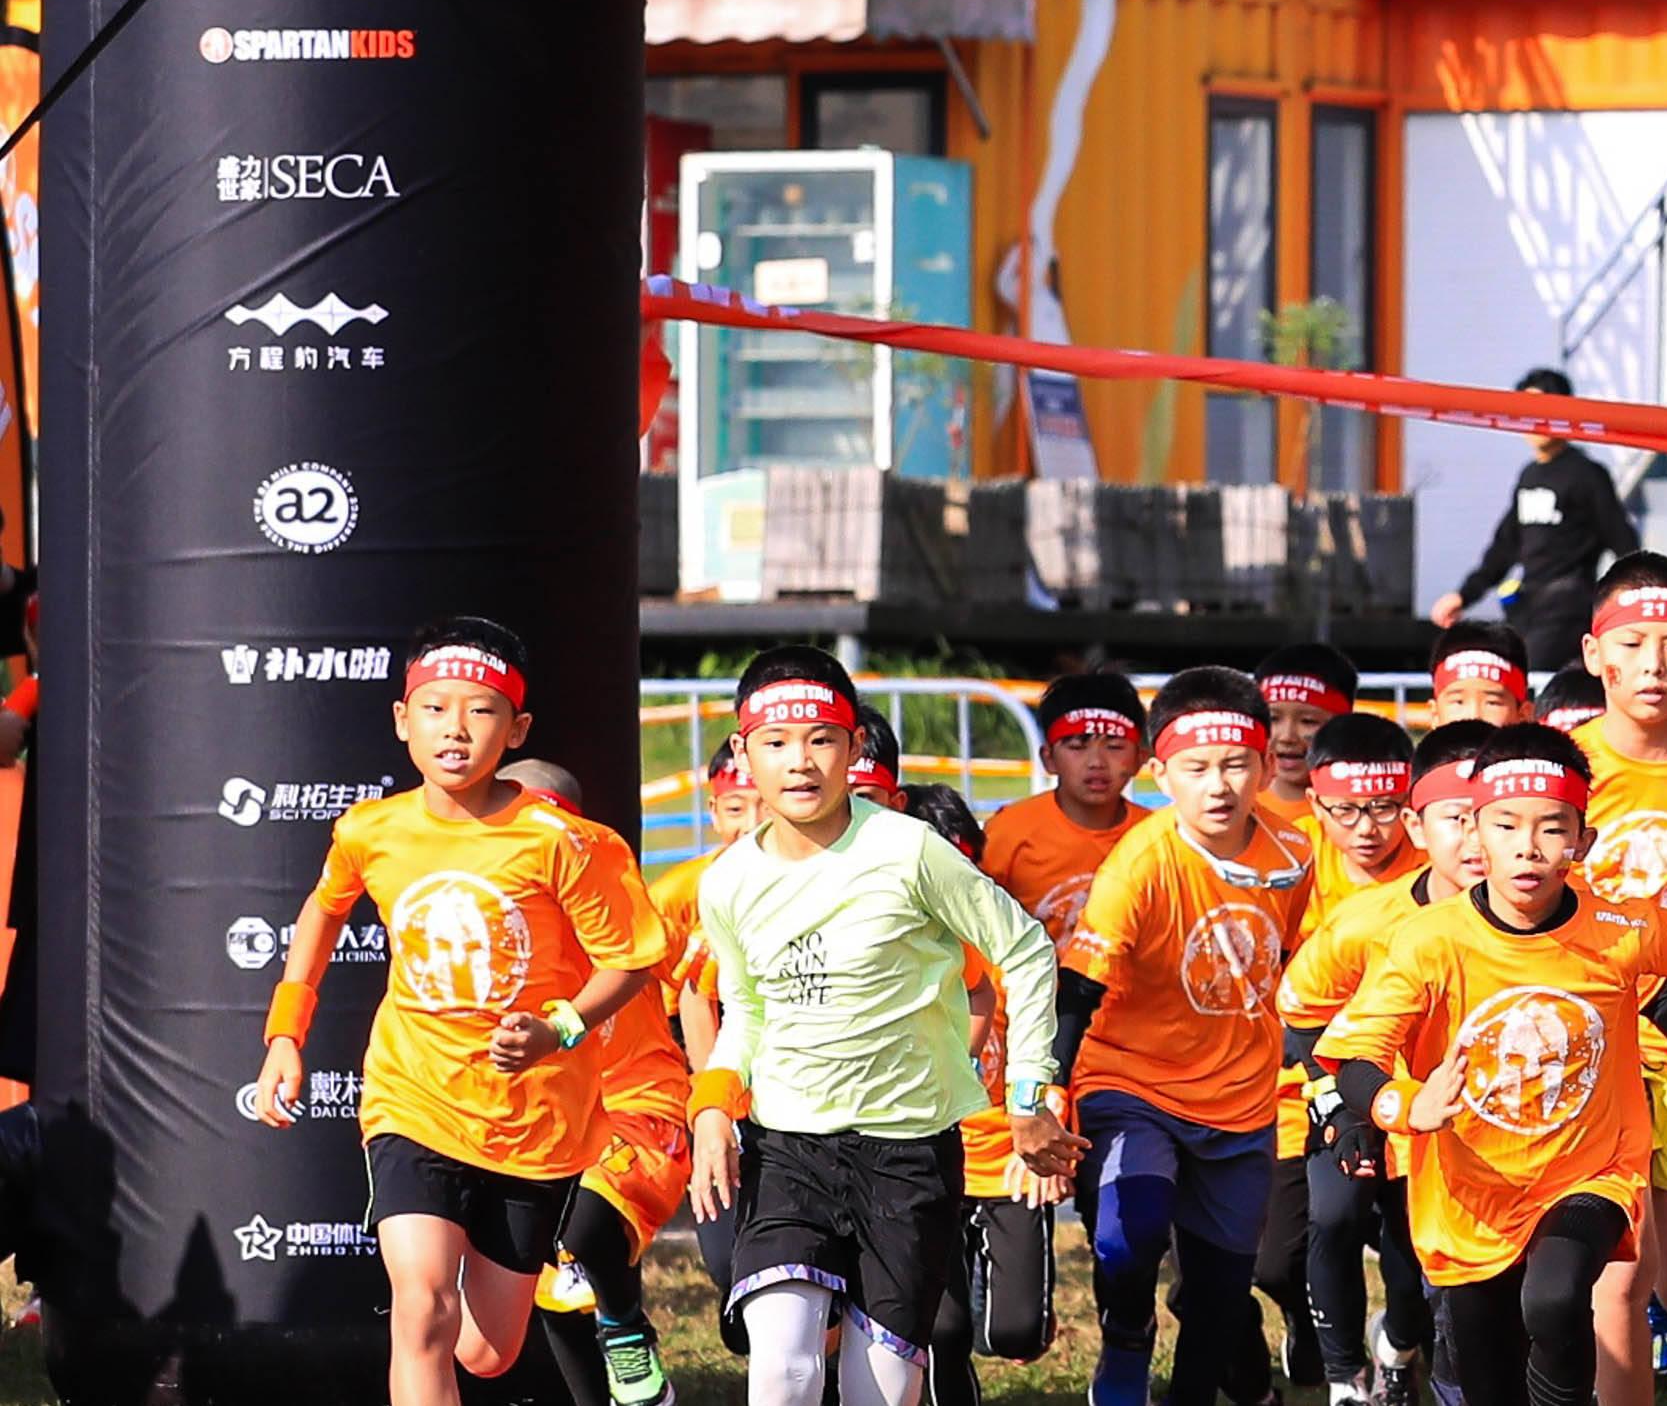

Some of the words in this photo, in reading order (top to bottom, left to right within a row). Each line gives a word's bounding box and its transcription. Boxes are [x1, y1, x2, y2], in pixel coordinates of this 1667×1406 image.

[233, 29, 415, 61] SPARTANKIDS
[269, 153, 401, 200] SECA
[274, 486, 339, 525] a2
[263, 646, 392, 682] 补水啦
[435, 661, 486, 682] 2111
[764, 702, 819, 723] 2006
[1493, 776, 1548, 796] 2118
[346, 950, 387, 963] CHINA
[787, 930, 823, 959] NO
[310, 1105, 337, 1119] DAI
